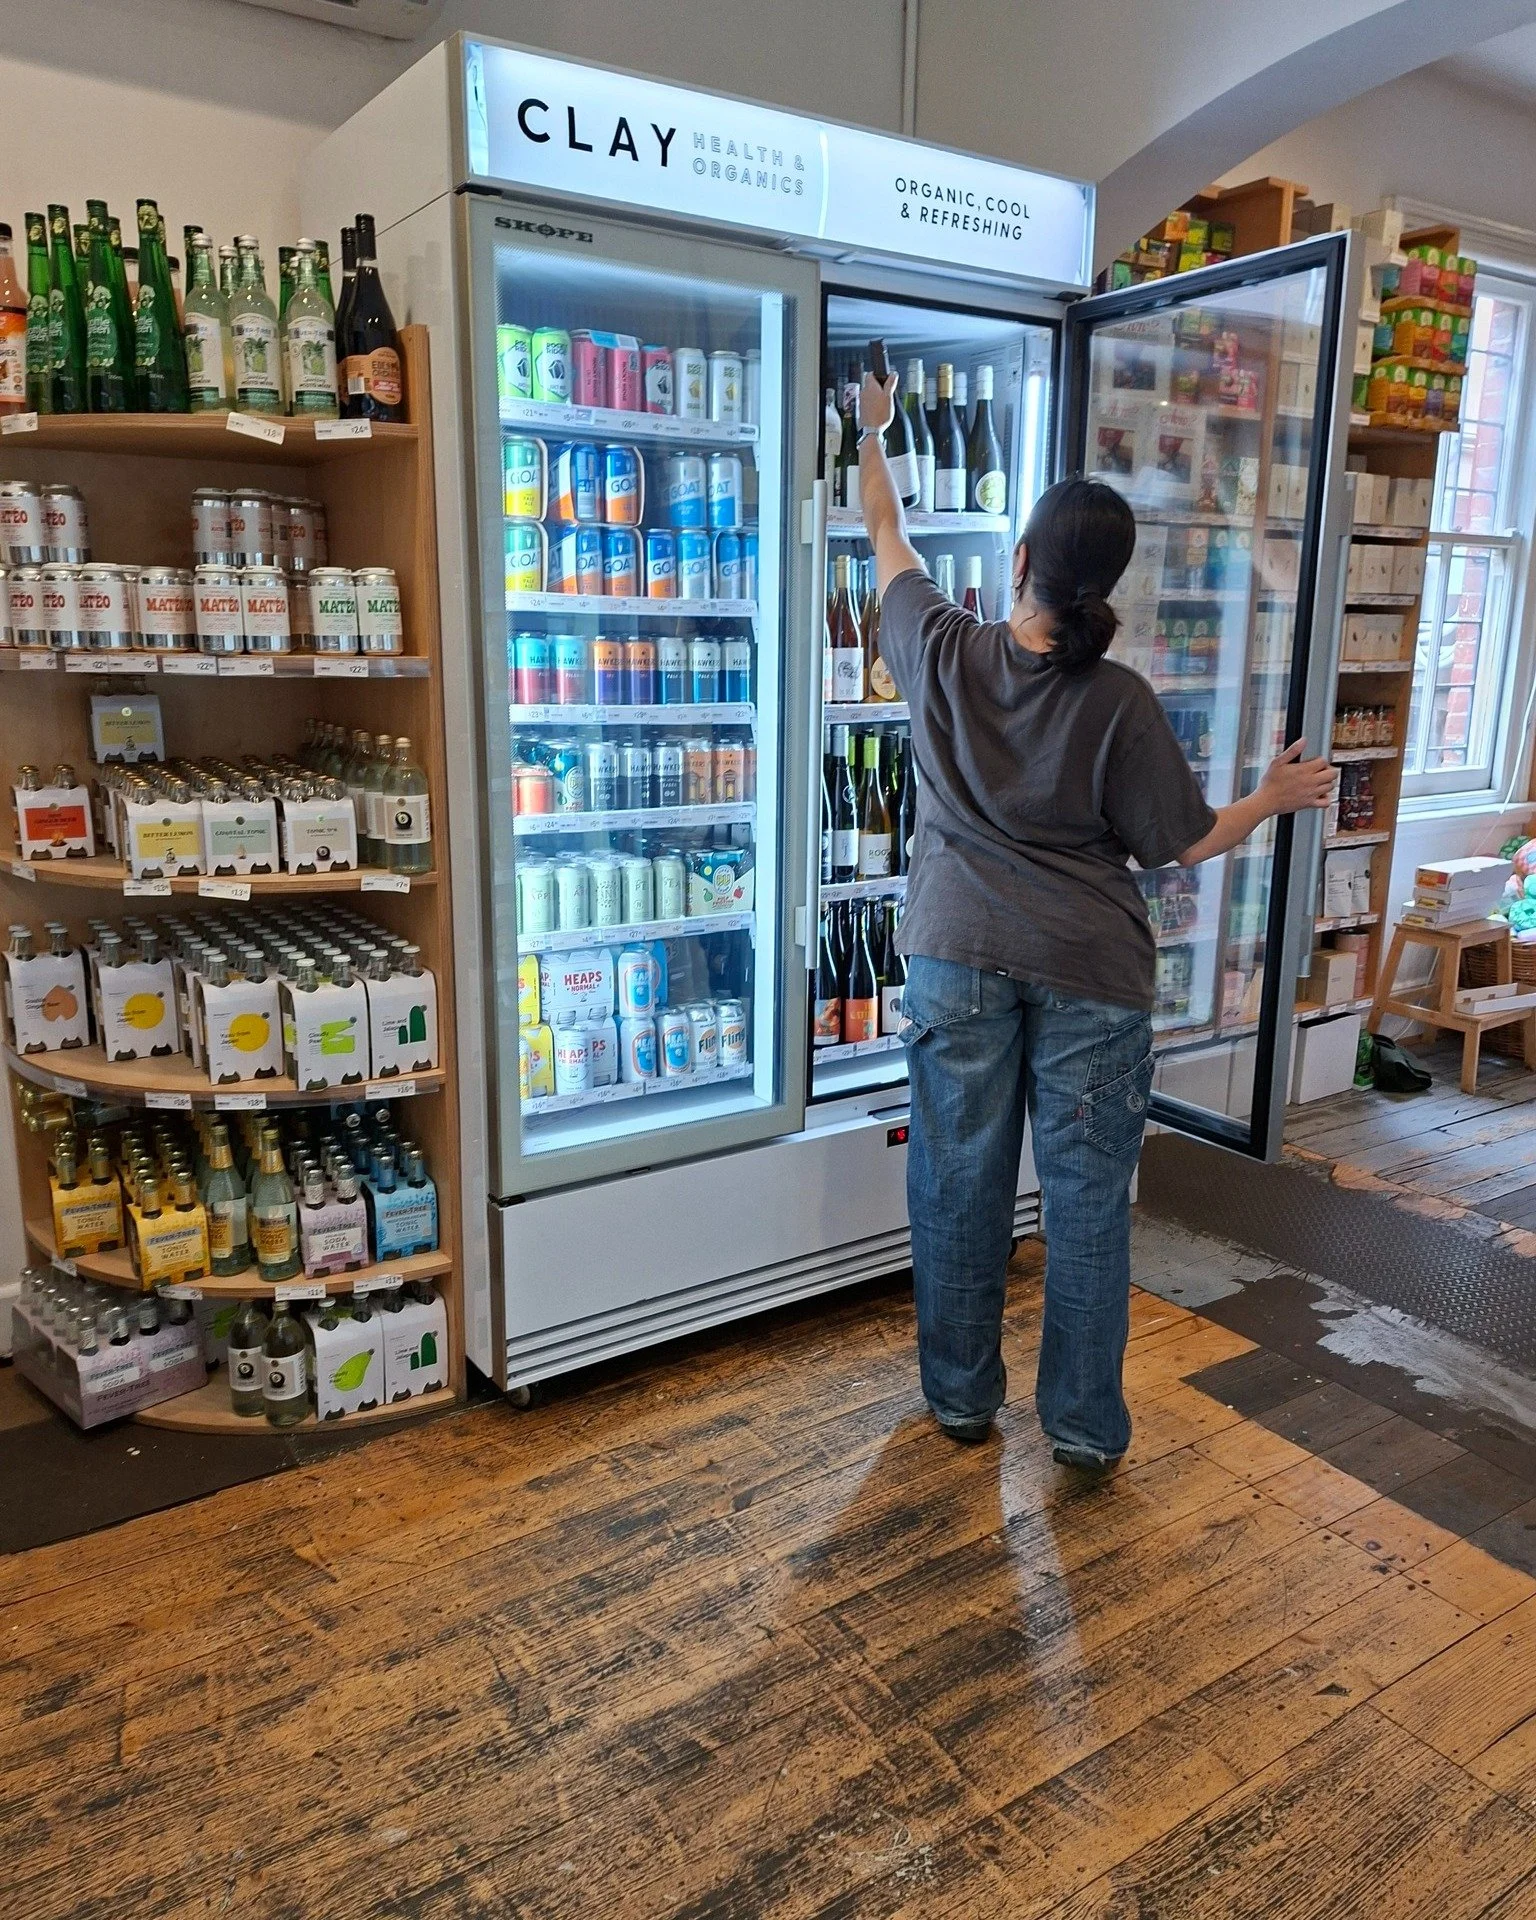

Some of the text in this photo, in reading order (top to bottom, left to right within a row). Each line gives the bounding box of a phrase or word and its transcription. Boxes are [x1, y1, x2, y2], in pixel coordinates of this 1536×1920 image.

[517, 98, 676, 168] CLAY
[693, 132, 805, 171] HEALTH &
[692, 157, 804, 195] ORGANICS
[900, 203, 1022, 240] & REFRESHING
[510, 470, 537, 484] GOA
[510, 553, 537, 568] GOA
[576, 554, 600, 570] OAT
[563, 970, 603, 986] HEAPS
[570, 983, 598, 993] NORMAL
[699, 1033, 716, 1054] Flin
[323, 1241, 350, 1251] WATER
[324, 1236, 347, 1245] SODA
